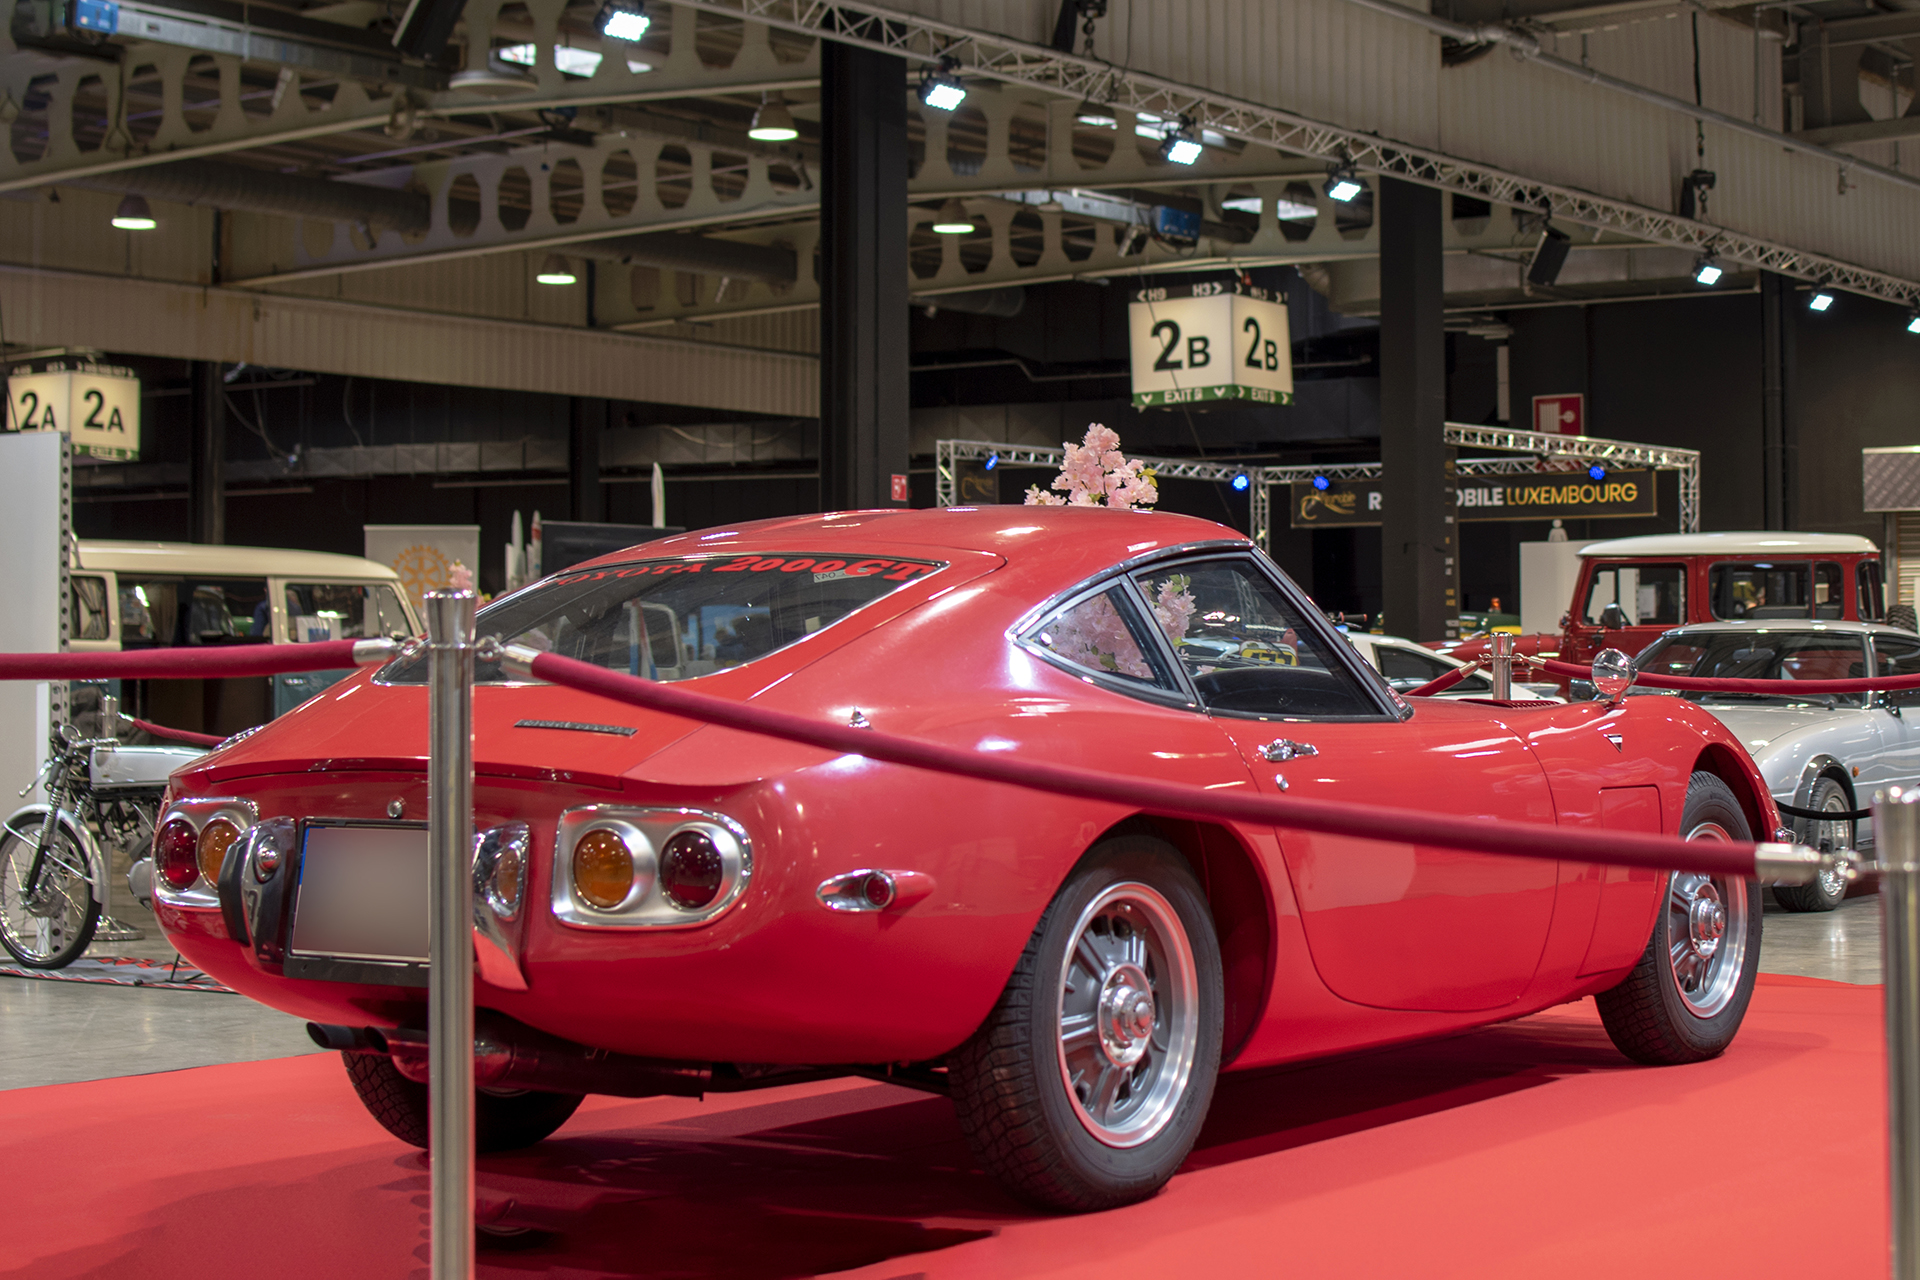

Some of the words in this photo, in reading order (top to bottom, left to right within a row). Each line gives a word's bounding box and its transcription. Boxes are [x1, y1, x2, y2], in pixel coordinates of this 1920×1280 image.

[1192, 283, 1211, 297] H3
[1151, 320, 1211, 372] 2B
[1243, 316, 1279, 371] 2B
[20, 390, 56, 430] 2A
[83, 389, 124, 433] 2A
[1164, 389, 1193, 403] EXIT
[1506, 482, 1638, 506] LUXEMBOURG
[712, 555, 938, 581] 2000GT
